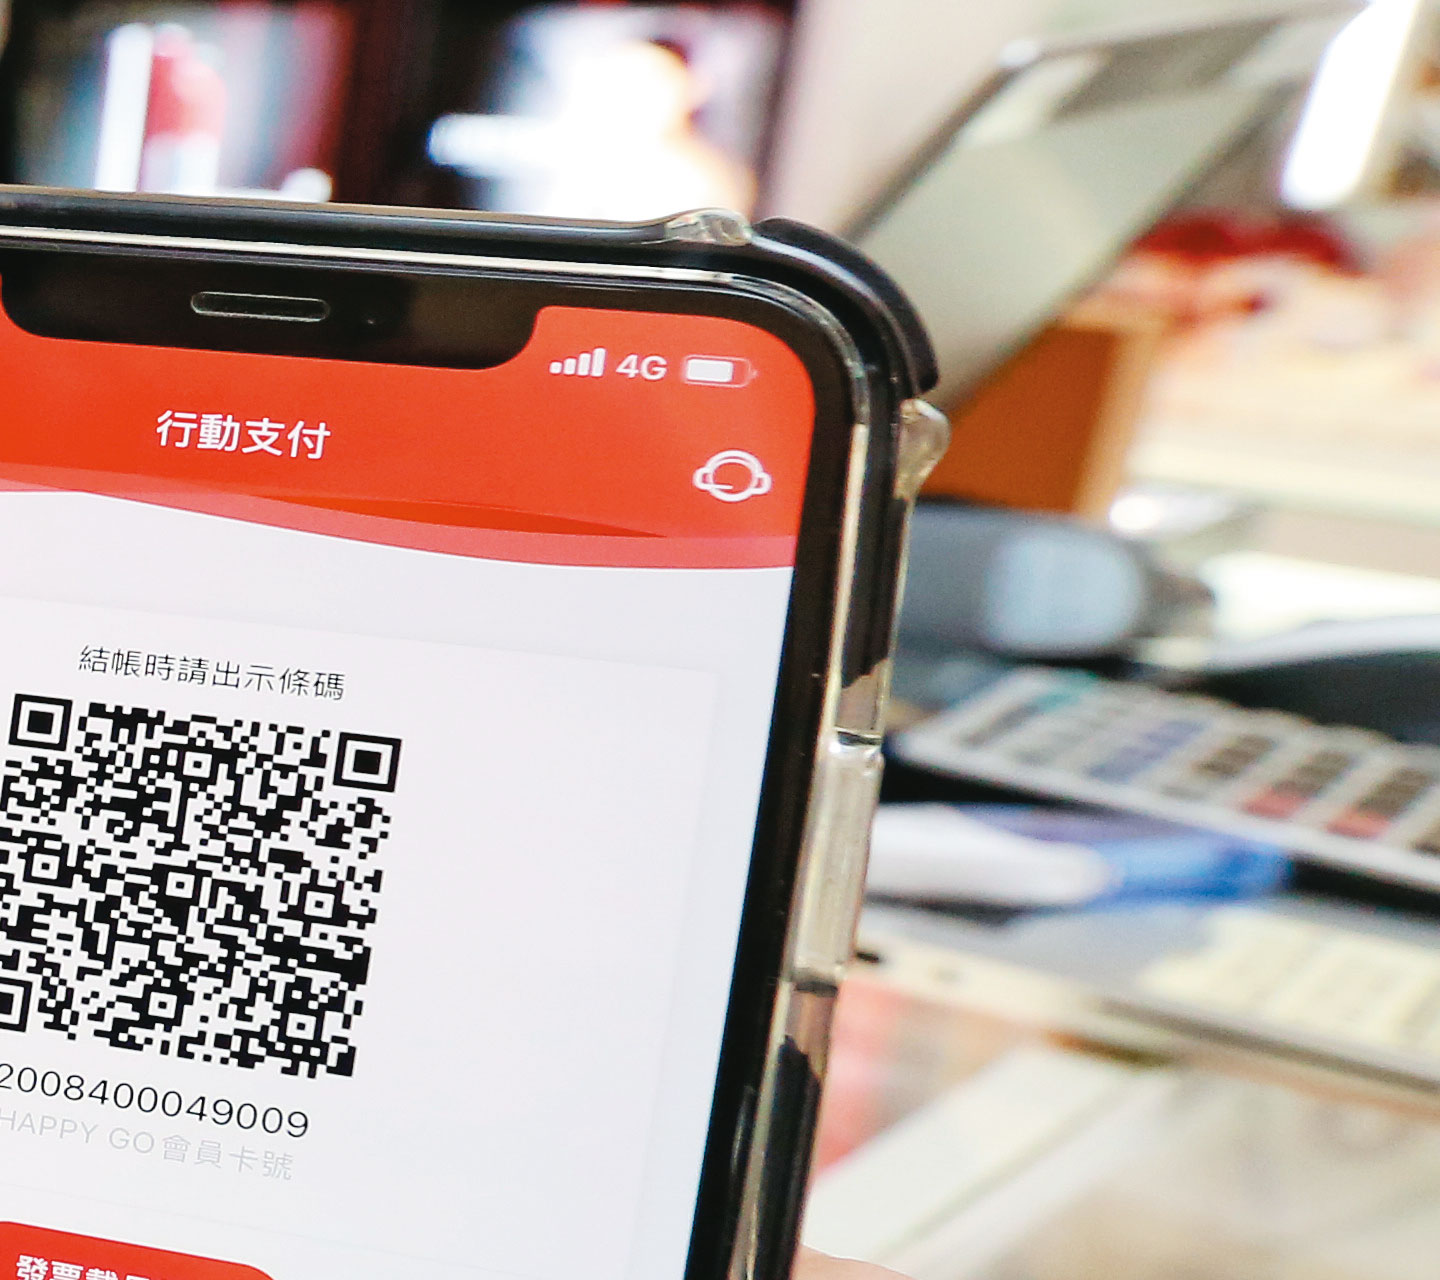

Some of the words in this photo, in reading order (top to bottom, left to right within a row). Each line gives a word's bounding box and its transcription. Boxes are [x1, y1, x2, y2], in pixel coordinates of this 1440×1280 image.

[616, 354, 667, 381] 4G
[156, 410, 331, 460] 行動支付
[78, 644, 346, 701] 結帳時請出示條碼
